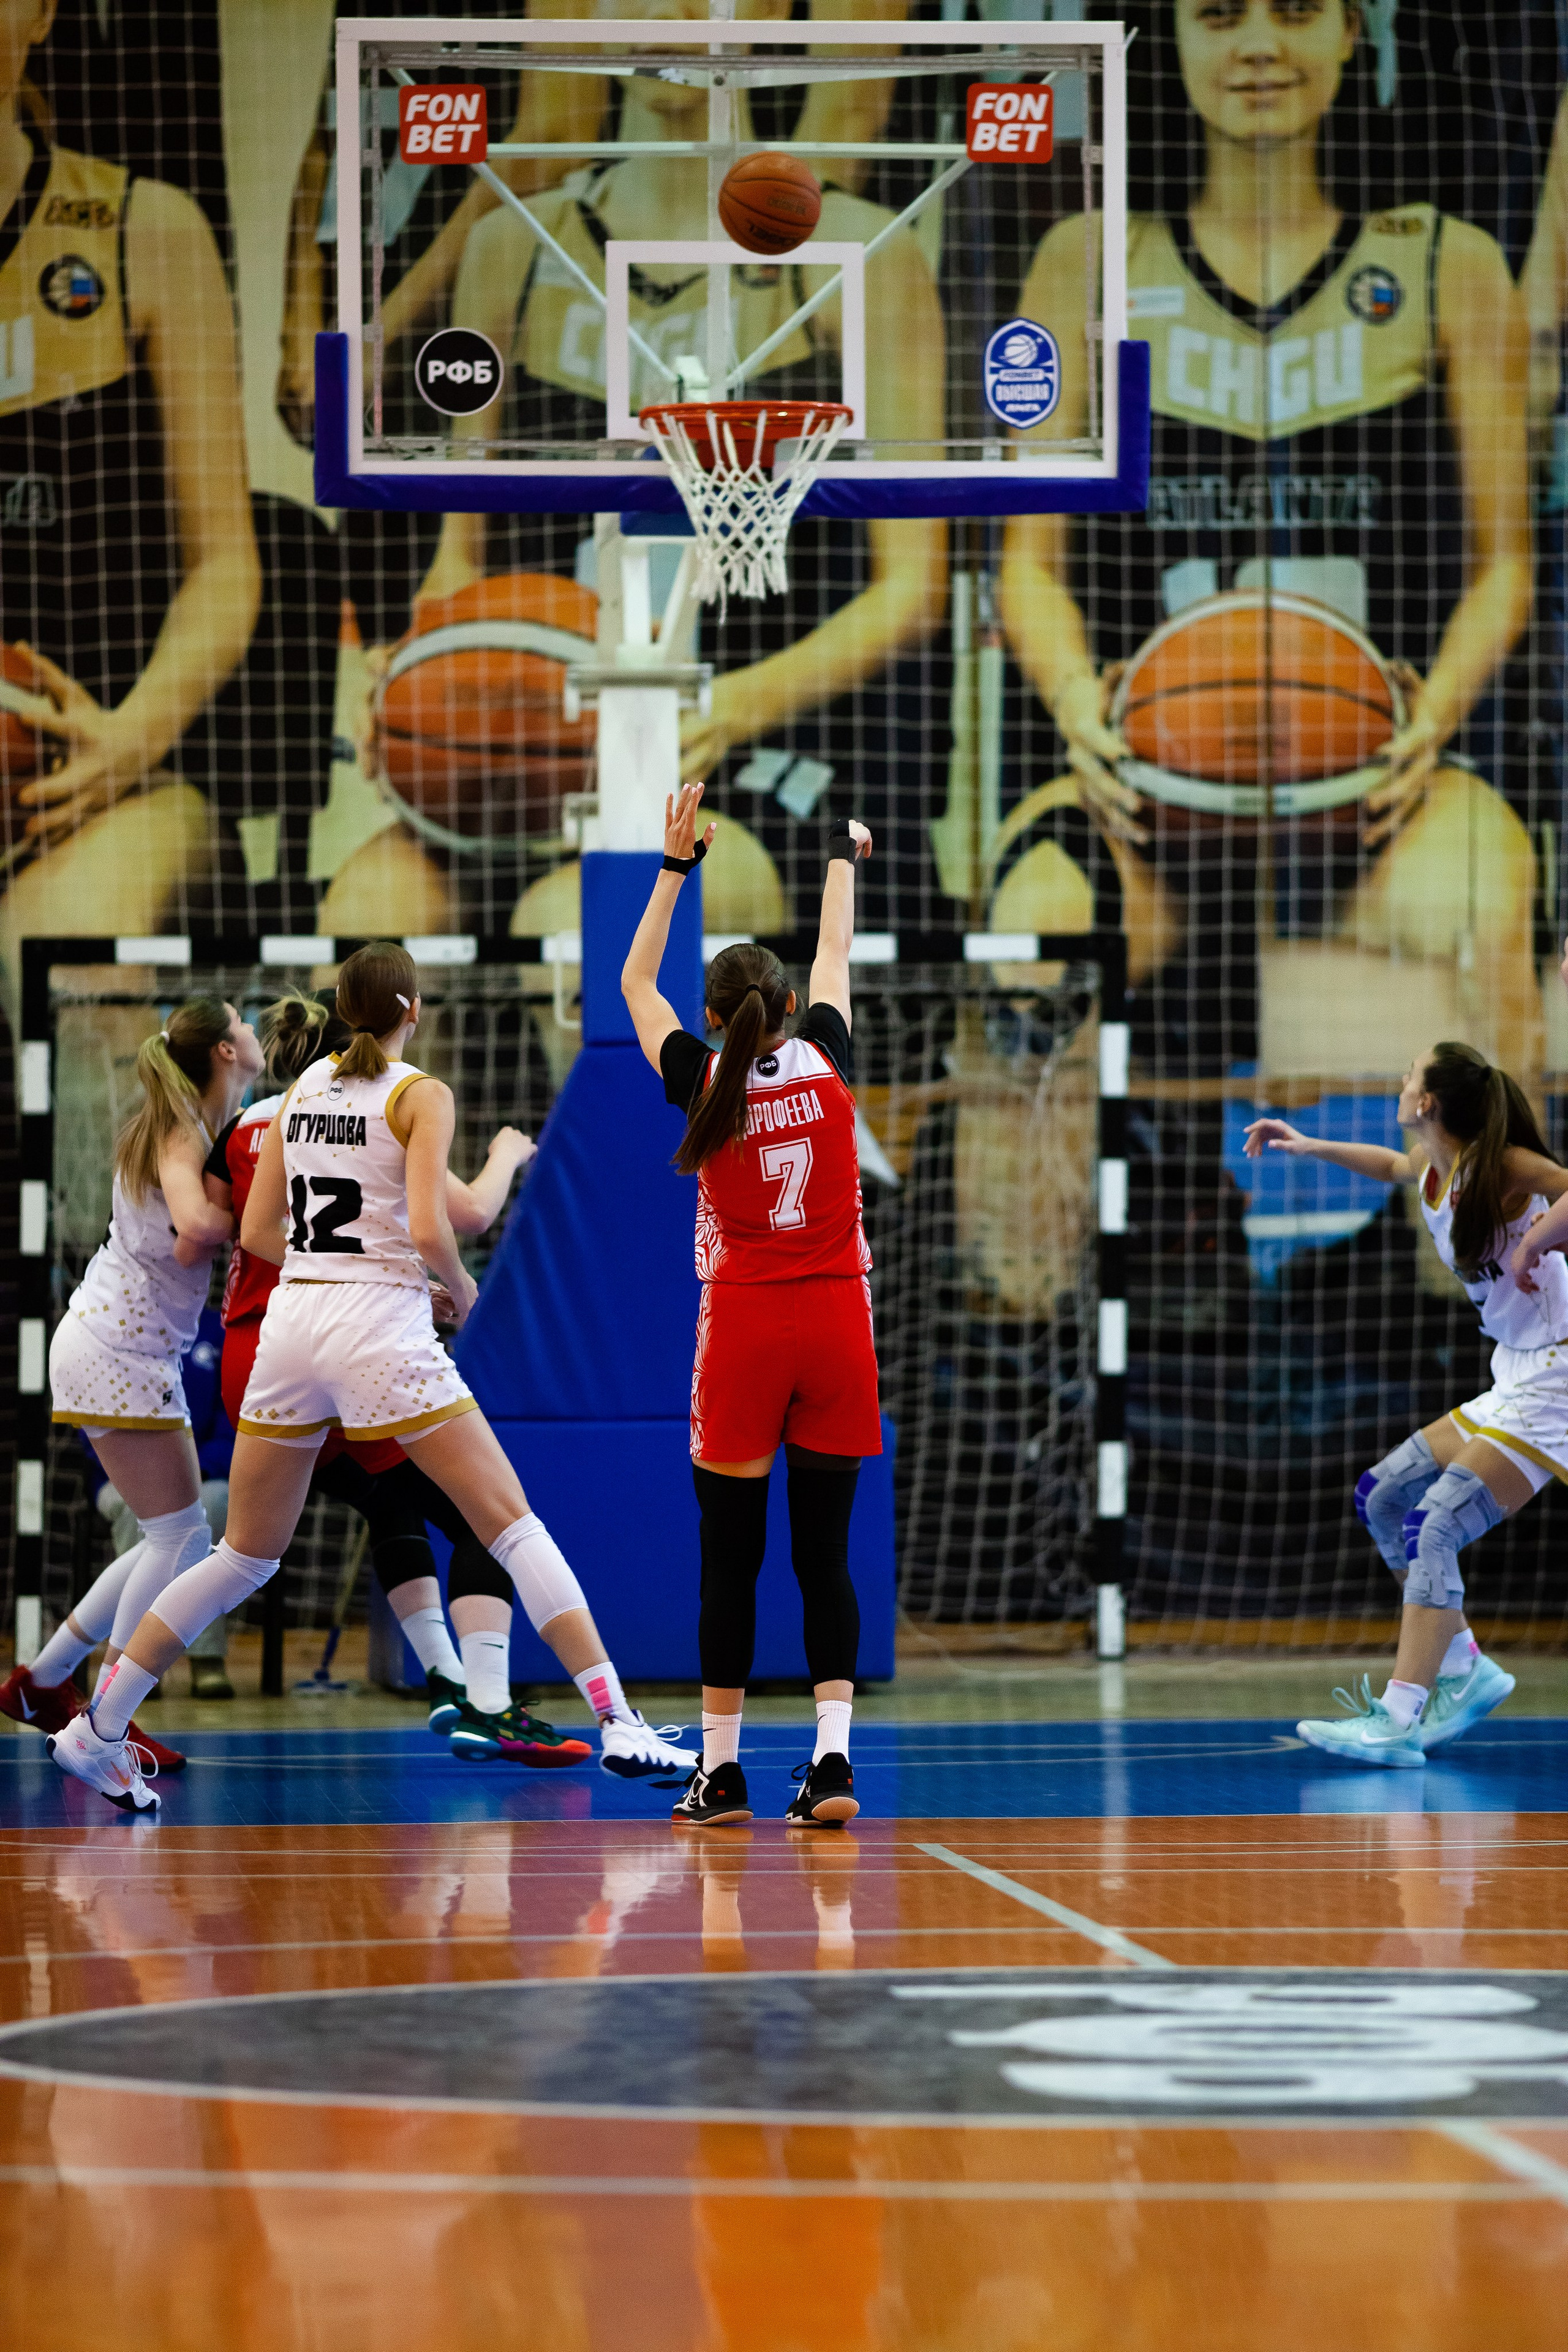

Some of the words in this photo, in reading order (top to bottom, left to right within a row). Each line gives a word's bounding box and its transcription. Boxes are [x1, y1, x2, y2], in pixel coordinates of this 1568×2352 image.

[405, 93, 481, 122] FON
[971, 92, 1049, 121] FON
[405, 124, 482, 153] BET
[971, 123, 1048, 153] BET
[427, 359, 493, 385] РФБ
[1167, 320, 1363, 424] CHGU
[759, 1060, 777, 1071] РФБ
[287, 1113, 366, 1146] ОГУРЦОВА
[737, 1089, 824, 1141] ОРОФЕЕВА
[758, 1137, 813, 1231] 7
[289, 1174, 366, 1254] 12
